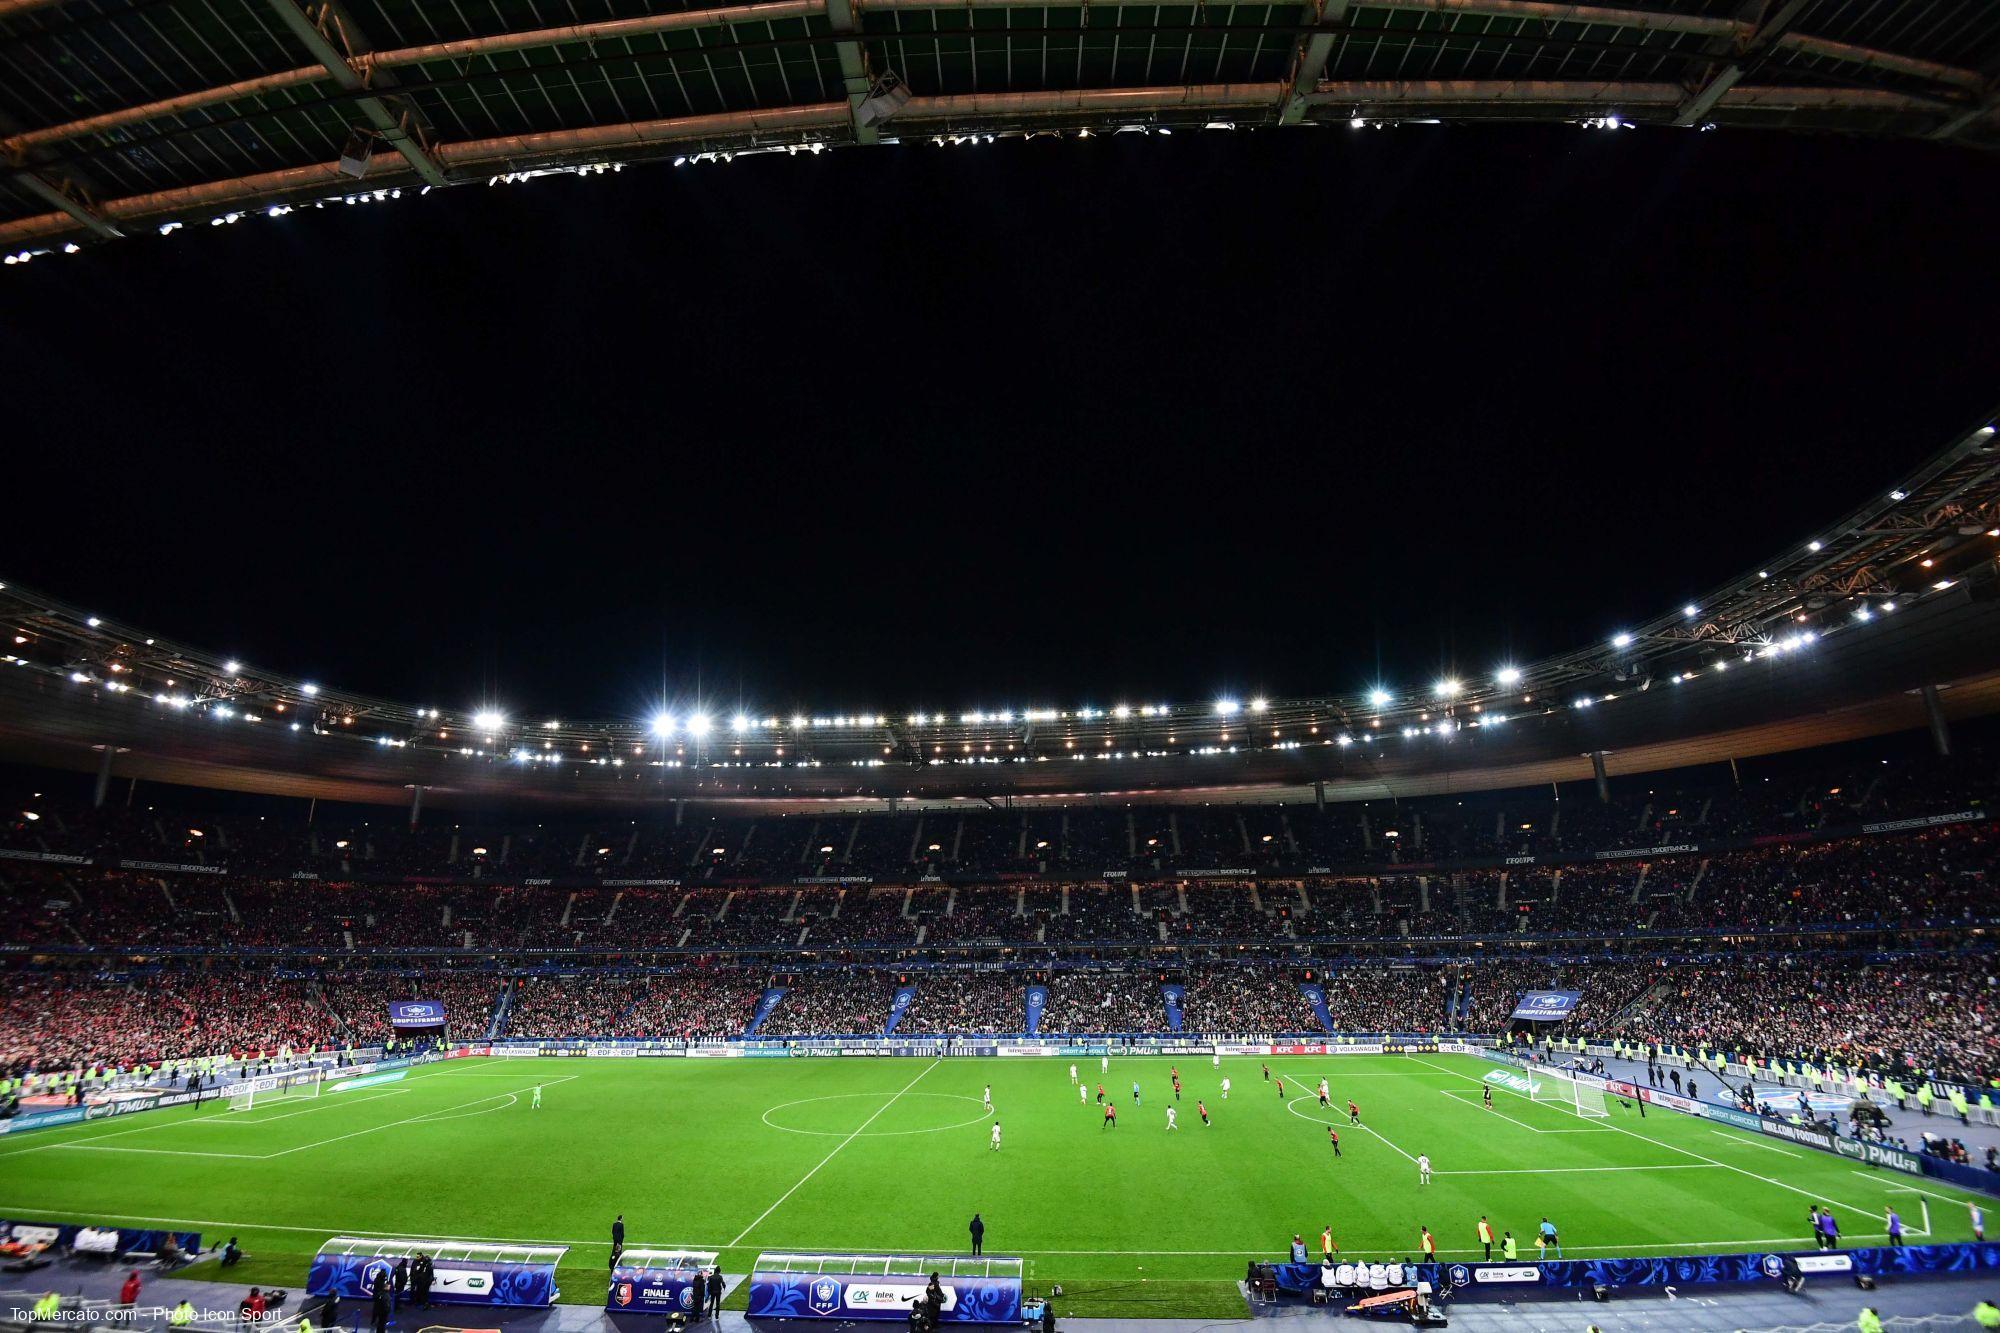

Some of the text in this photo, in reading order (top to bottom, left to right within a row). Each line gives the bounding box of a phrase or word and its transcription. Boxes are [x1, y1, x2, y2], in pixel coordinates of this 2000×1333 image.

[913, 1047, 935, 1056] COUPE
[950, 1047, 977, 1056] FRANCE
[1610, 1081, 1623, 1093] KFC
[1631, 1087, 1646, 1099] KC
[1729, 1113, 1760, 1127] AGRICOLE
[1762, 1120, 1831, 1148] NIKE.COM/FOOTBALL
[643, 1288, 670, 1298] FINALE
